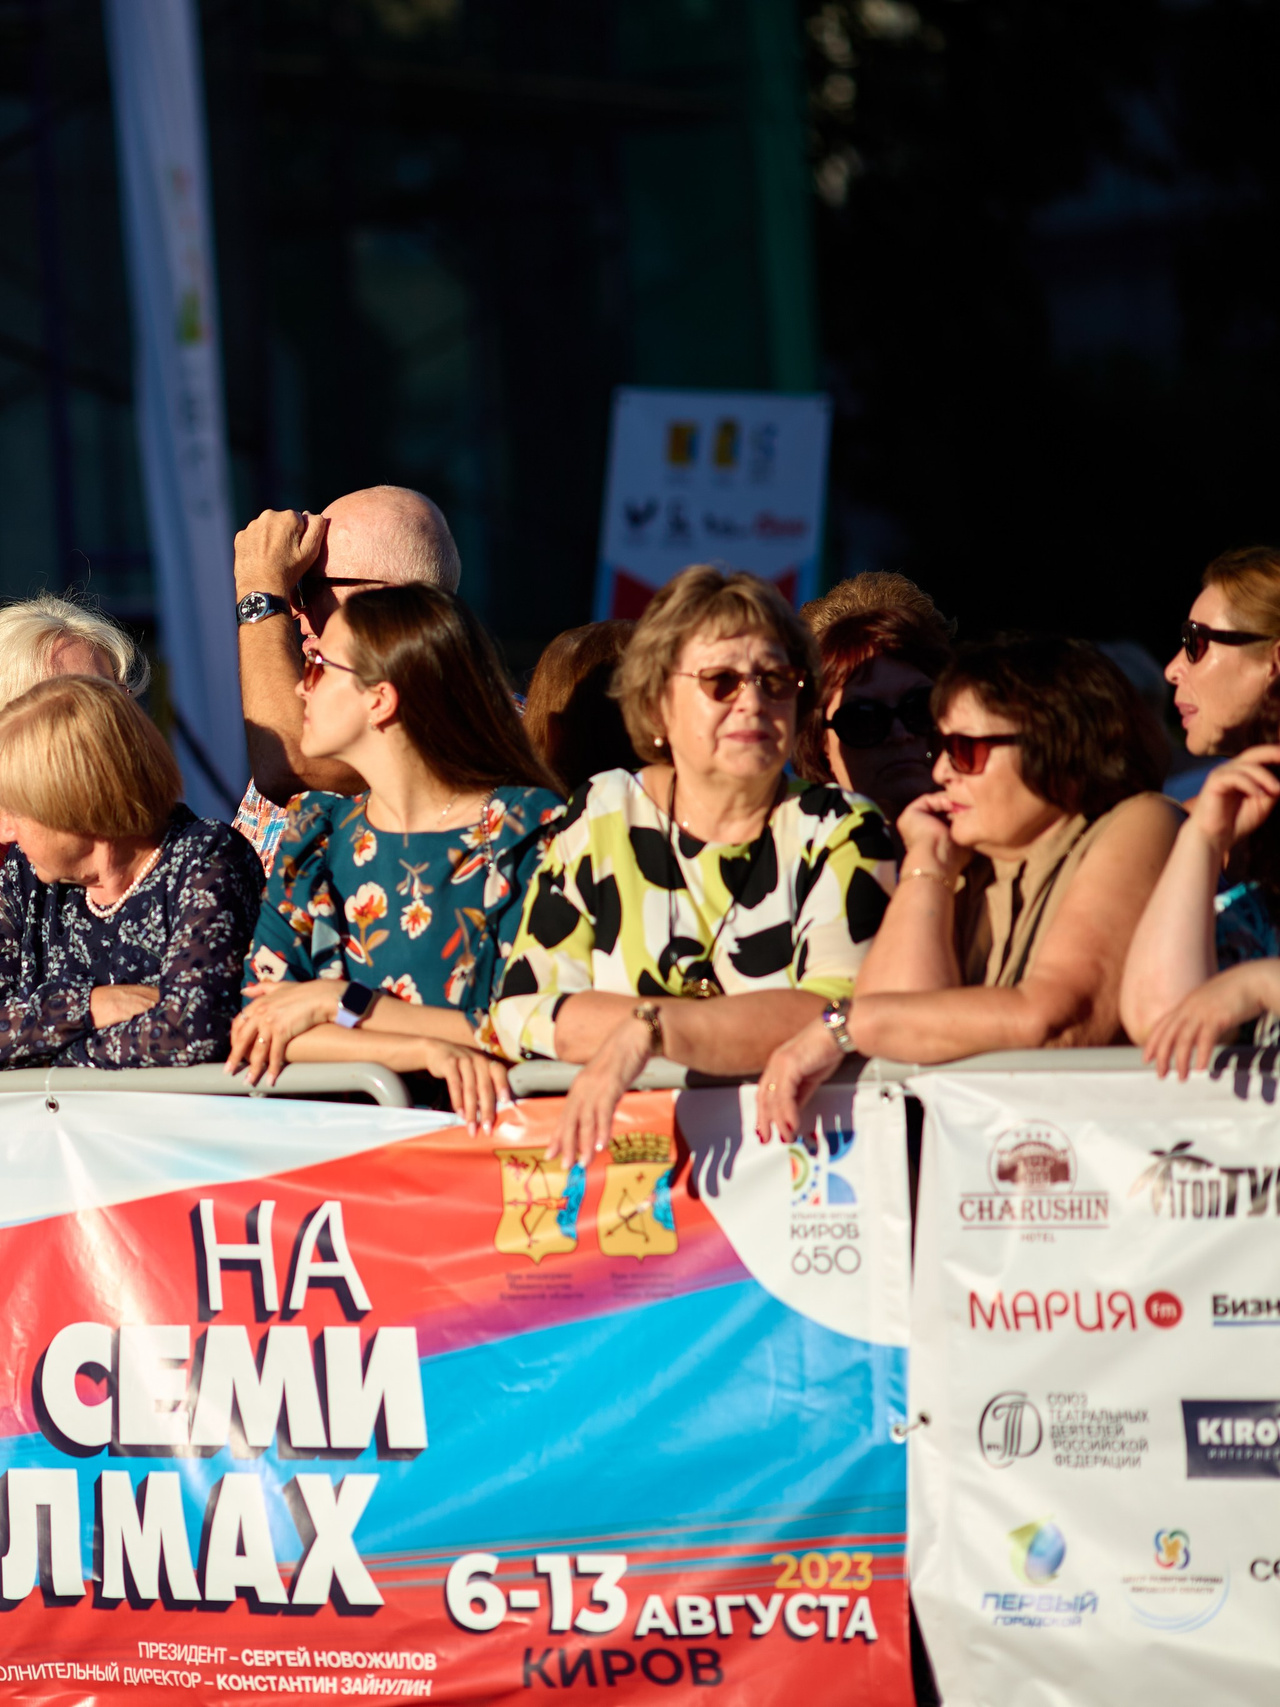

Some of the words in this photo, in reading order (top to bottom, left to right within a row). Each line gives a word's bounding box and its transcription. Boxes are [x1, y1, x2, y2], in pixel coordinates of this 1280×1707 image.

[959, 1197, 1109, 1222] CHARUSHIN
[790, 1223, 860, 1240] КИРОВ
[1020, 1232, 1056, 1243] HOTEL
[190, 1199, 372, 1322] НА
[791, 1244, 861, 1275] 650
[969, 1290, 1137, 1332] МАРИЯ
[32, 1321, 427, 1460] СЕМИ
[1198, 1417, 1280, 1447] KIRO
[770, 1552, 874, 1590] 2023
[445, 1552, 628, 1634] 6-13
[981, 1591, 1098, 1614] ПЕРВЫЙ
[634, 1593, 878, 1641] АВГУСТА
[138, 1641, 227, 1665] ПРЕЗИДЕНТ
[241, 1646, 309, 1667] СЕРГЕЙ
[313, 1650, 437, 1671] НОВОЖИЛОВ
[521, 1647, 726, 1688] КИРОВ
[123, 1667, 201, 1688] ДИРЕКТОР
[216, 1674, 337, 1694] КОНСТАНТИН
[340, 1674, 432, 1697] ЗАЙНУЛИН
